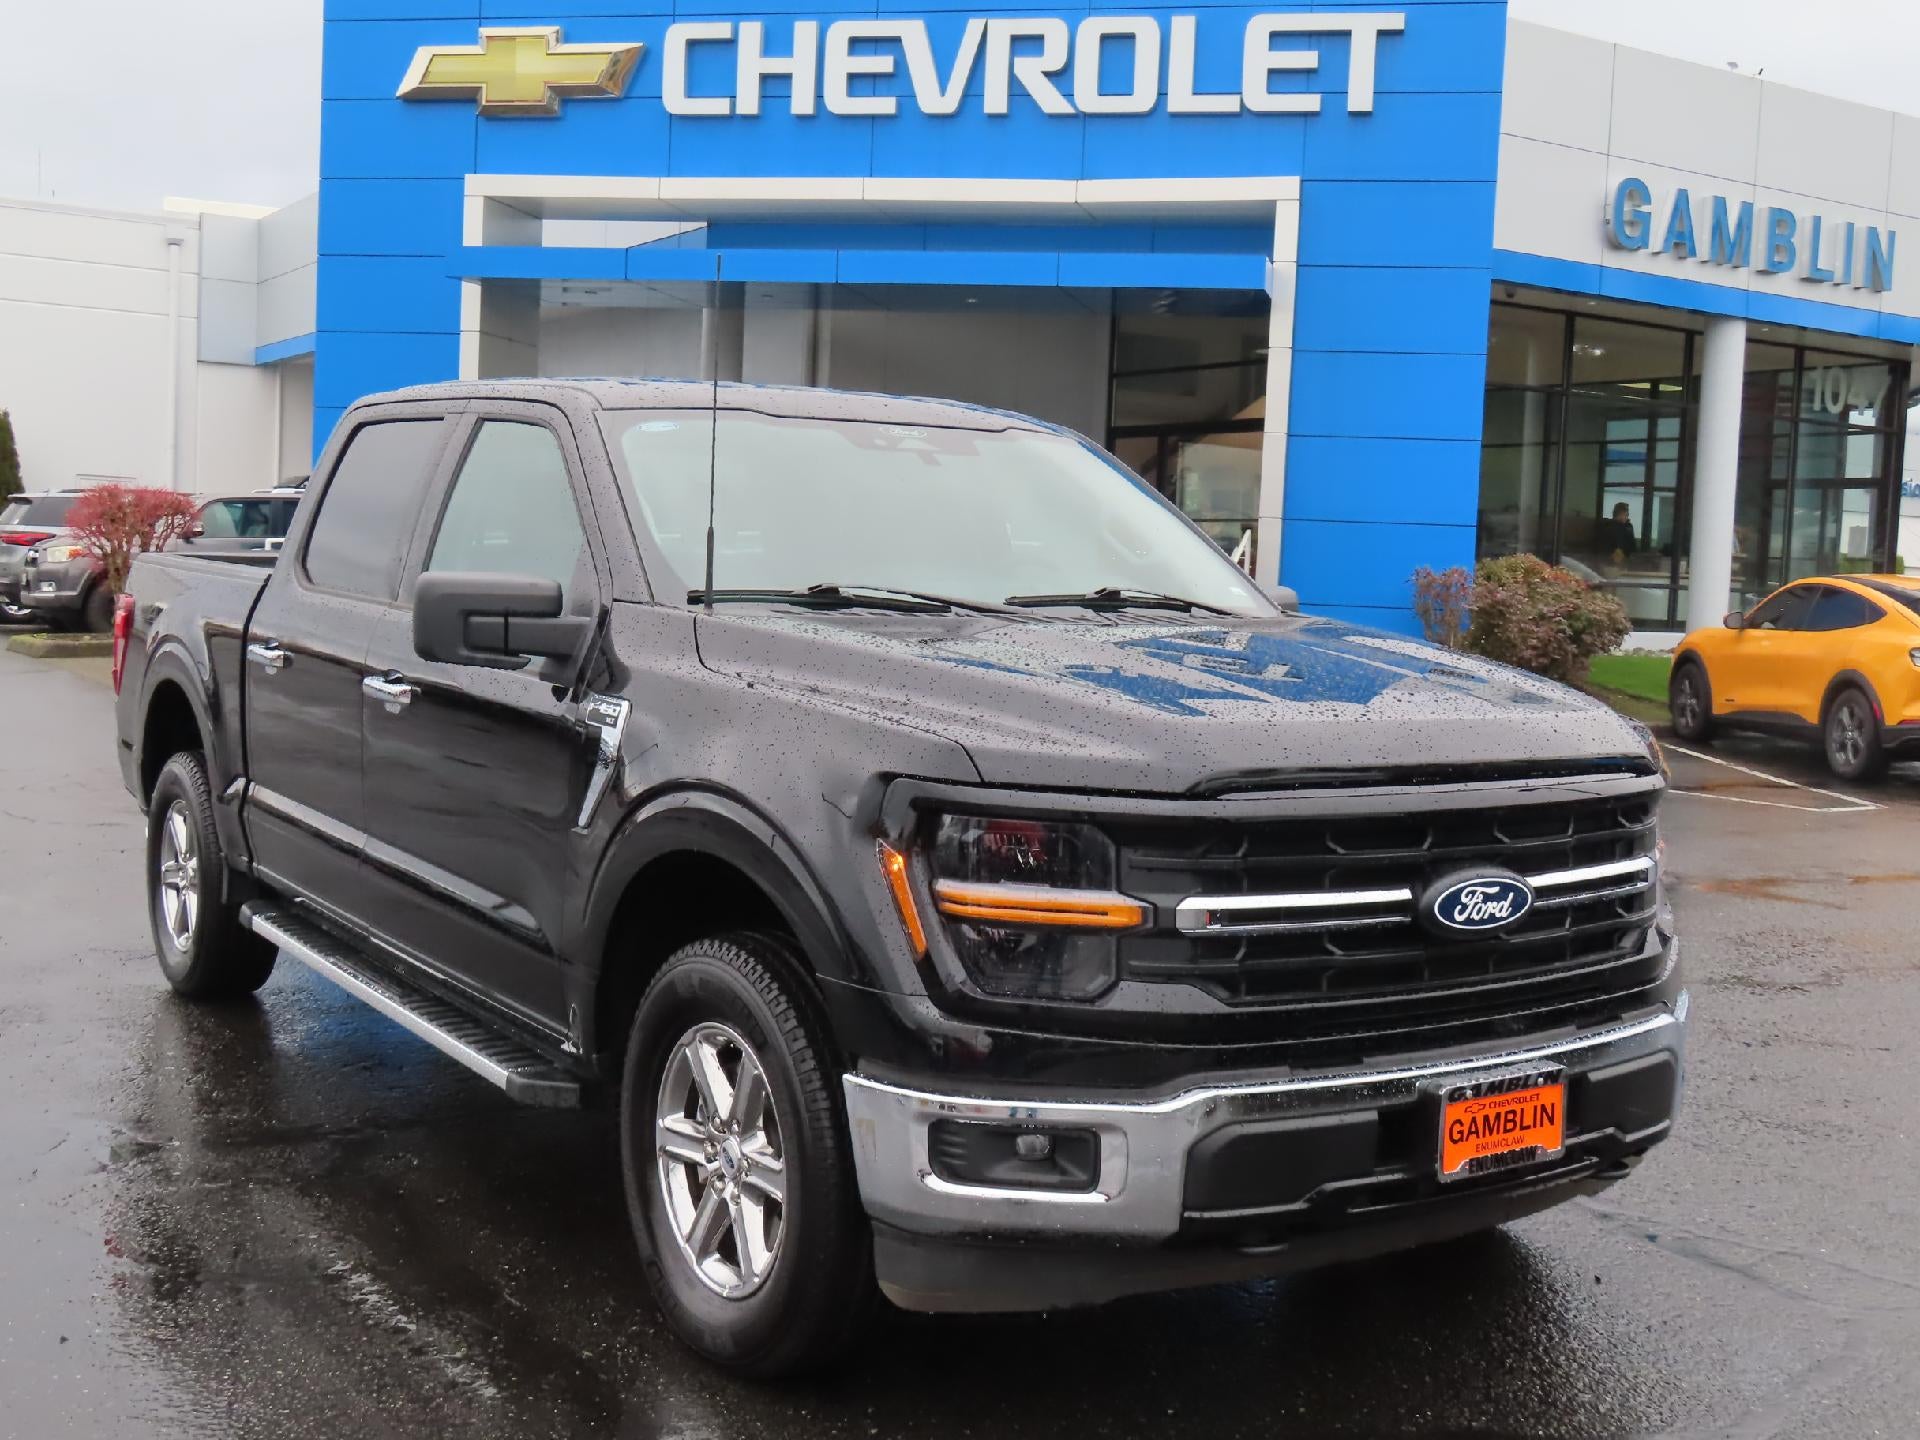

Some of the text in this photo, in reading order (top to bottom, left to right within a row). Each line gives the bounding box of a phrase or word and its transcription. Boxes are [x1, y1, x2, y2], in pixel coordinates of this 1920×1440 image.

[661, 13, 1405, 117] CHEVROLET
[1604, 177, 1897, 292] GAMBLIN
[1809, 366, 1892, 418] 1047
[1453, 886, 1515, 922] Ford
[1488, 1093, 1540, 1109] CHEVROLET
[1448, 1103, 1555, 1145] GAMBLIN
[1475, 1135, 1525, 1153] ENUMCLAW
